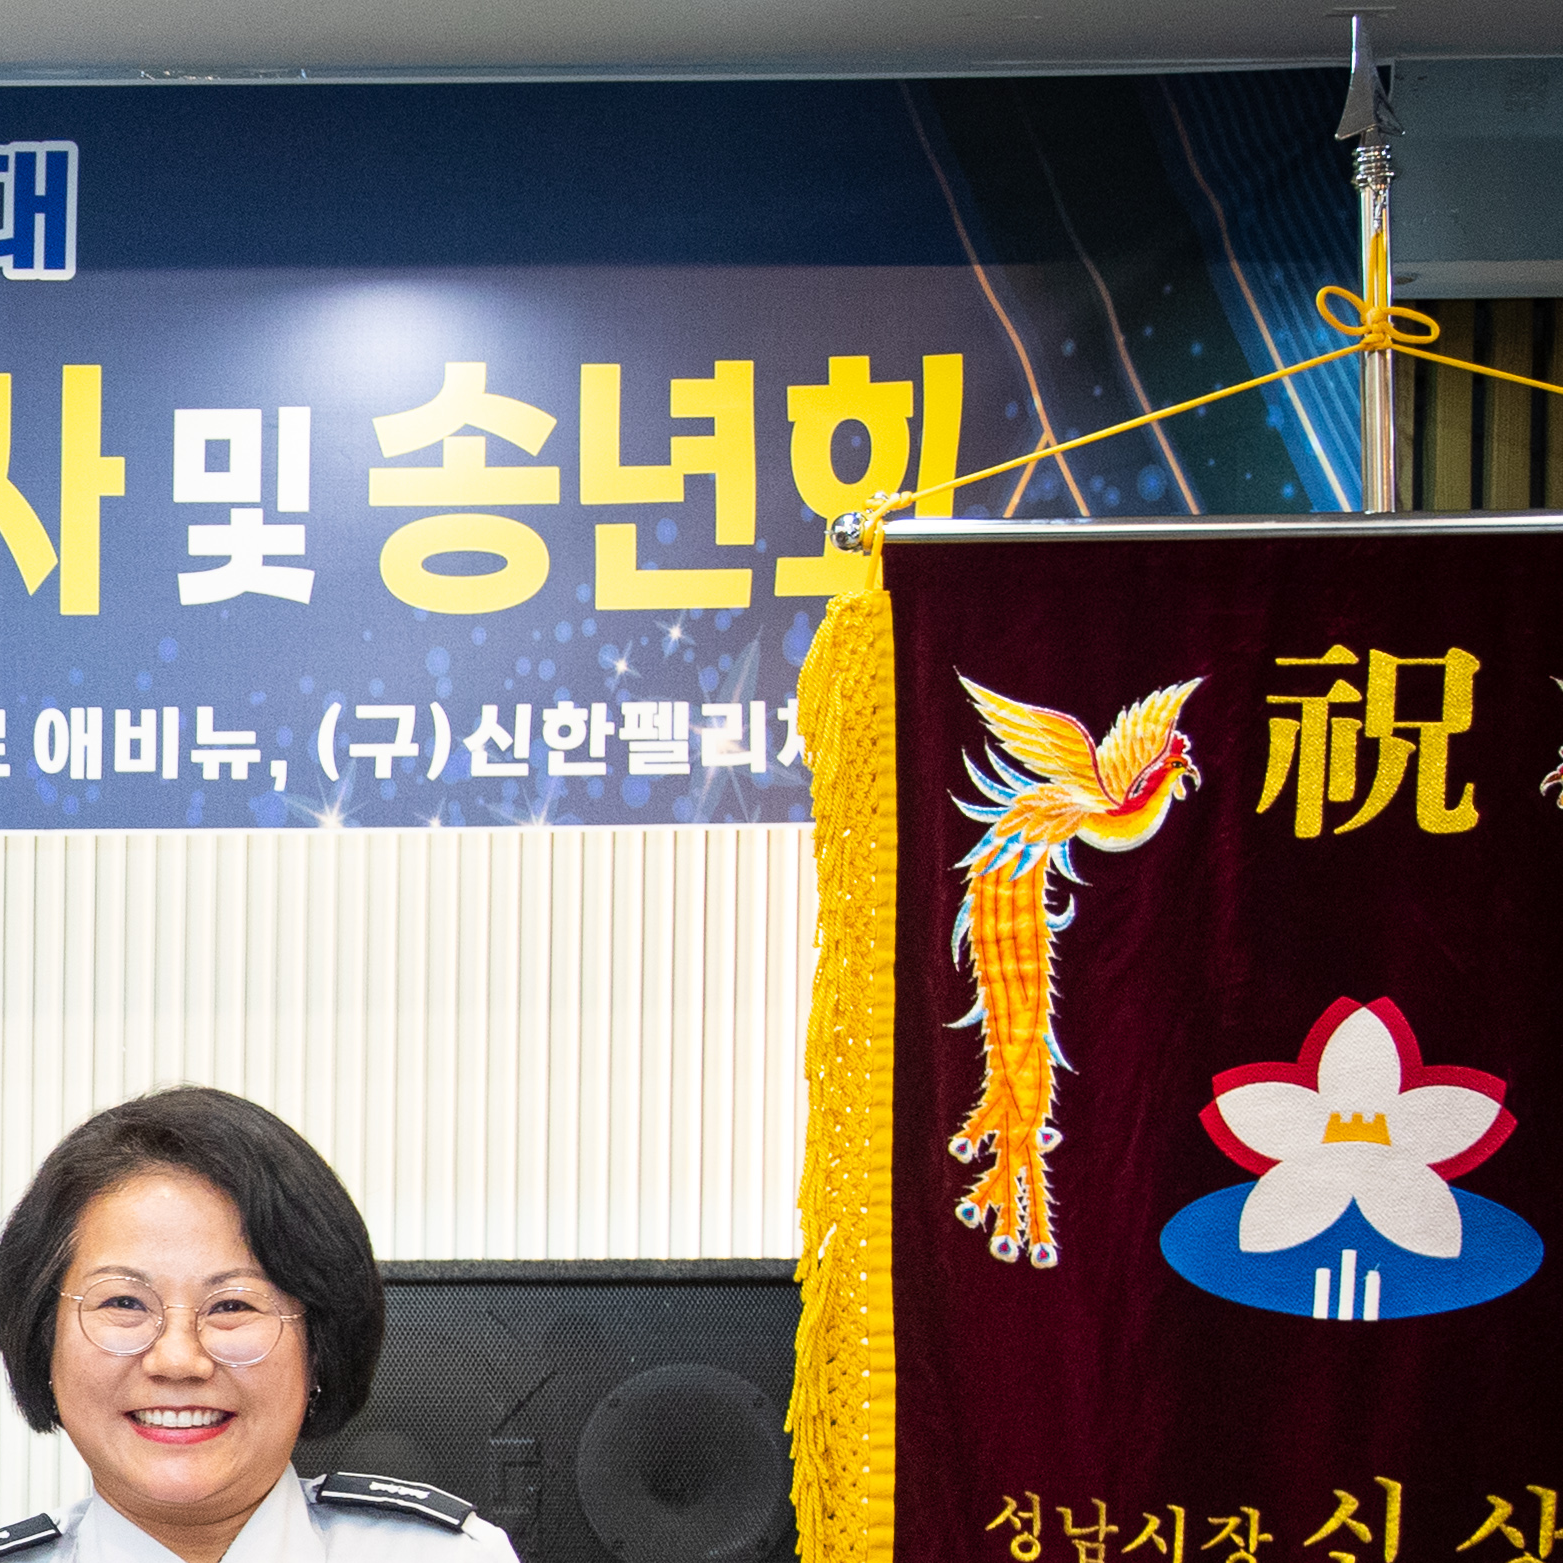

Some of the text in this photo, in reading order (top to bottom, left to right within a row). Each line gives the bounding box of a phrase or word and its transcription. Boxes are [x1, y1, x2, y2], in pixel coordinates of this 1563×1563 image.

[173, 405, 315, 605] 및
[368, 353, 964, 615] 송년회
[33, 705, 288, 791] 애비뉴,
[1256, 645, 1480, 838] 祝
